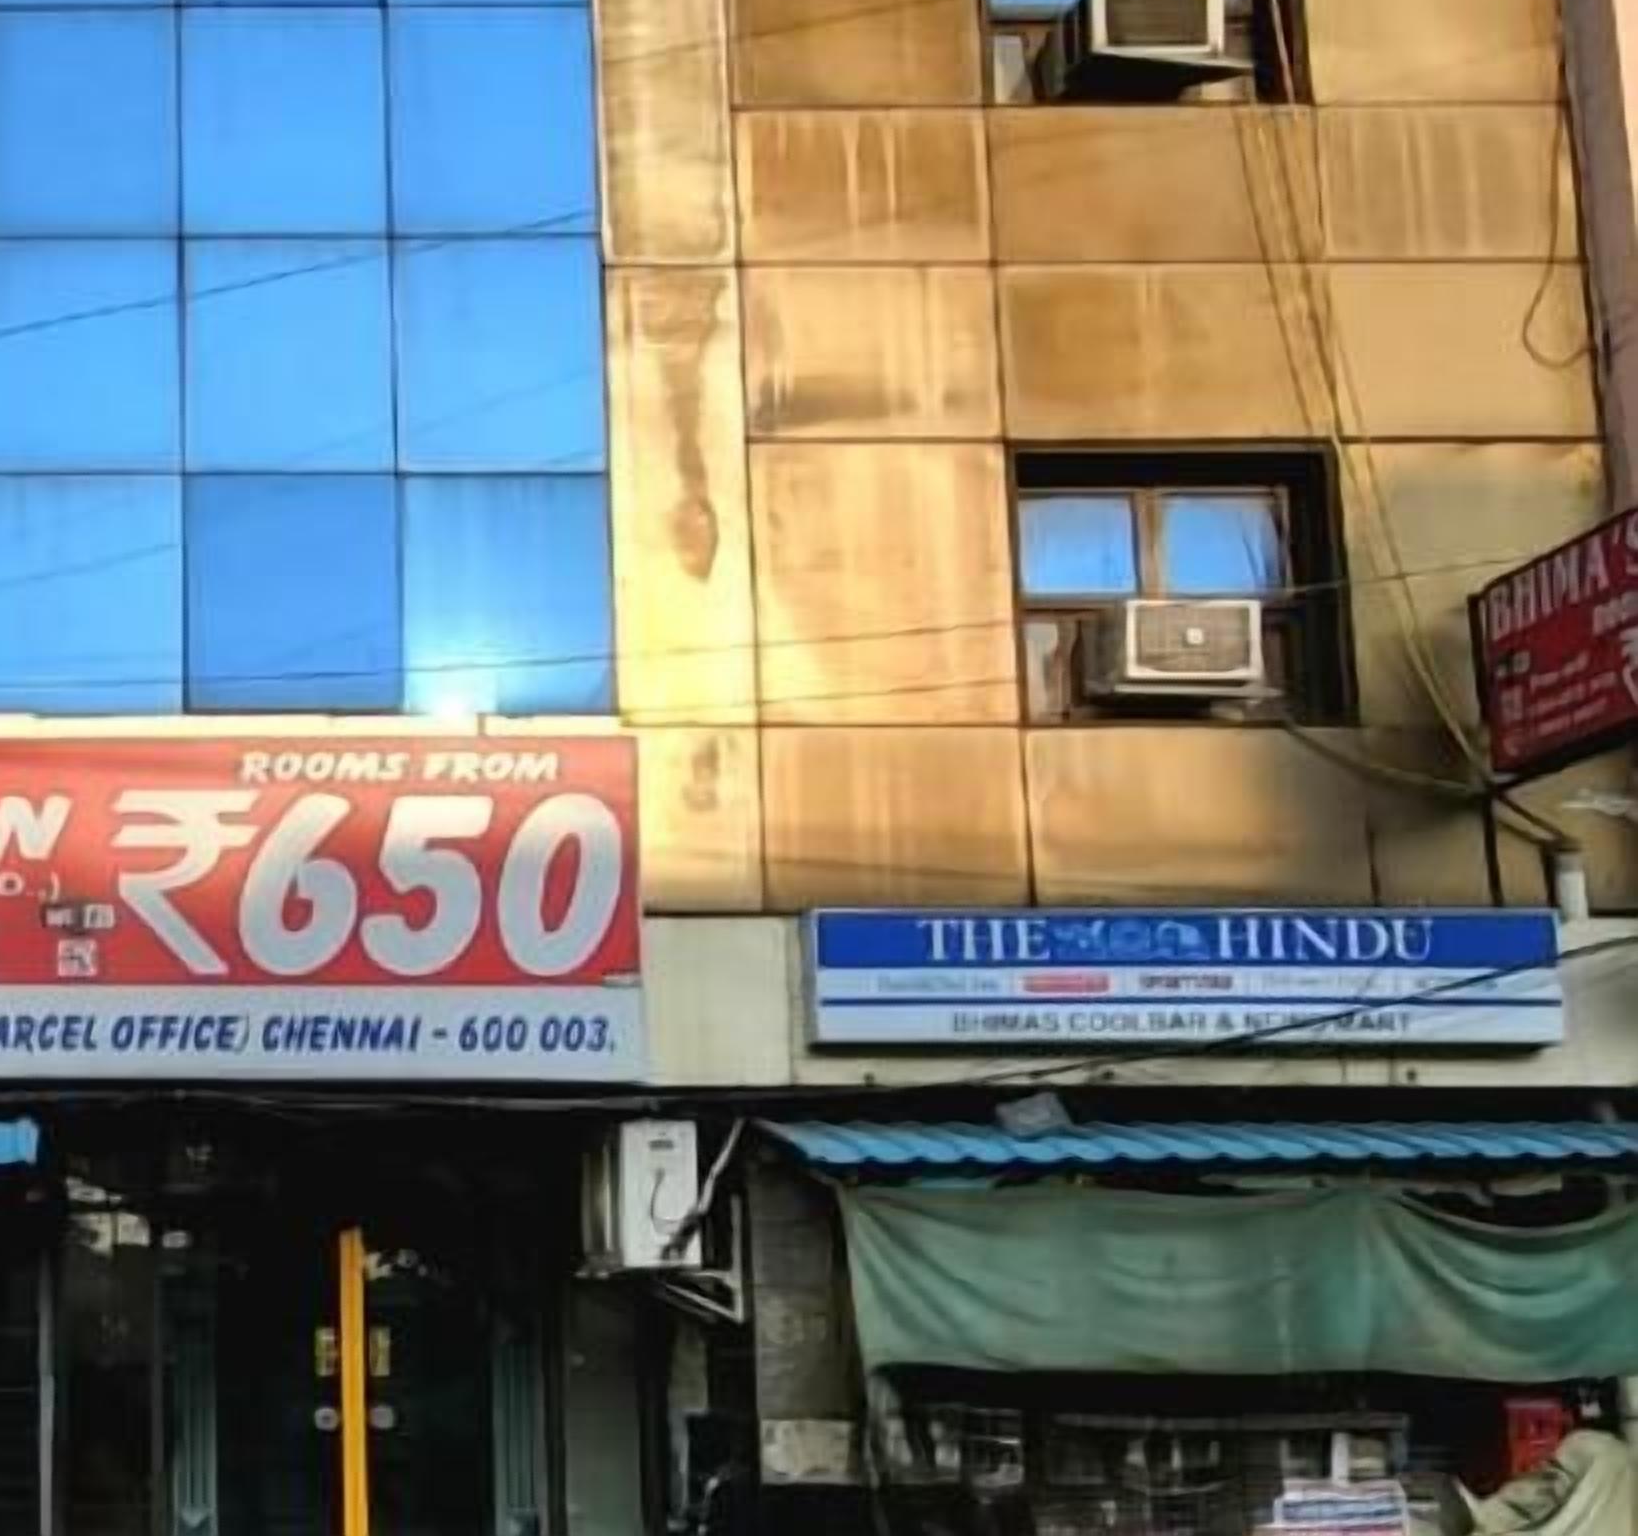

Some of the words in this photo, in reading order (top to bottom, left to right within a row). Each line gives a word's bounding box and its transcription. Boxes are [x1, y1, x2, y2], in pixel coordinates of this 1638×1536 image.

[242, 752, 410, 782] ROOMS
[423, 752, 557, 782] FROM
[916, 918, 1052, 961] THE
[1217, 918, 1436, 961] HINDU
[110, 1014, 251, 1052] OFFICE)
[262, 1015, 423, 1052] CHENNAI
[459, 1015, 528, 1052] 600
